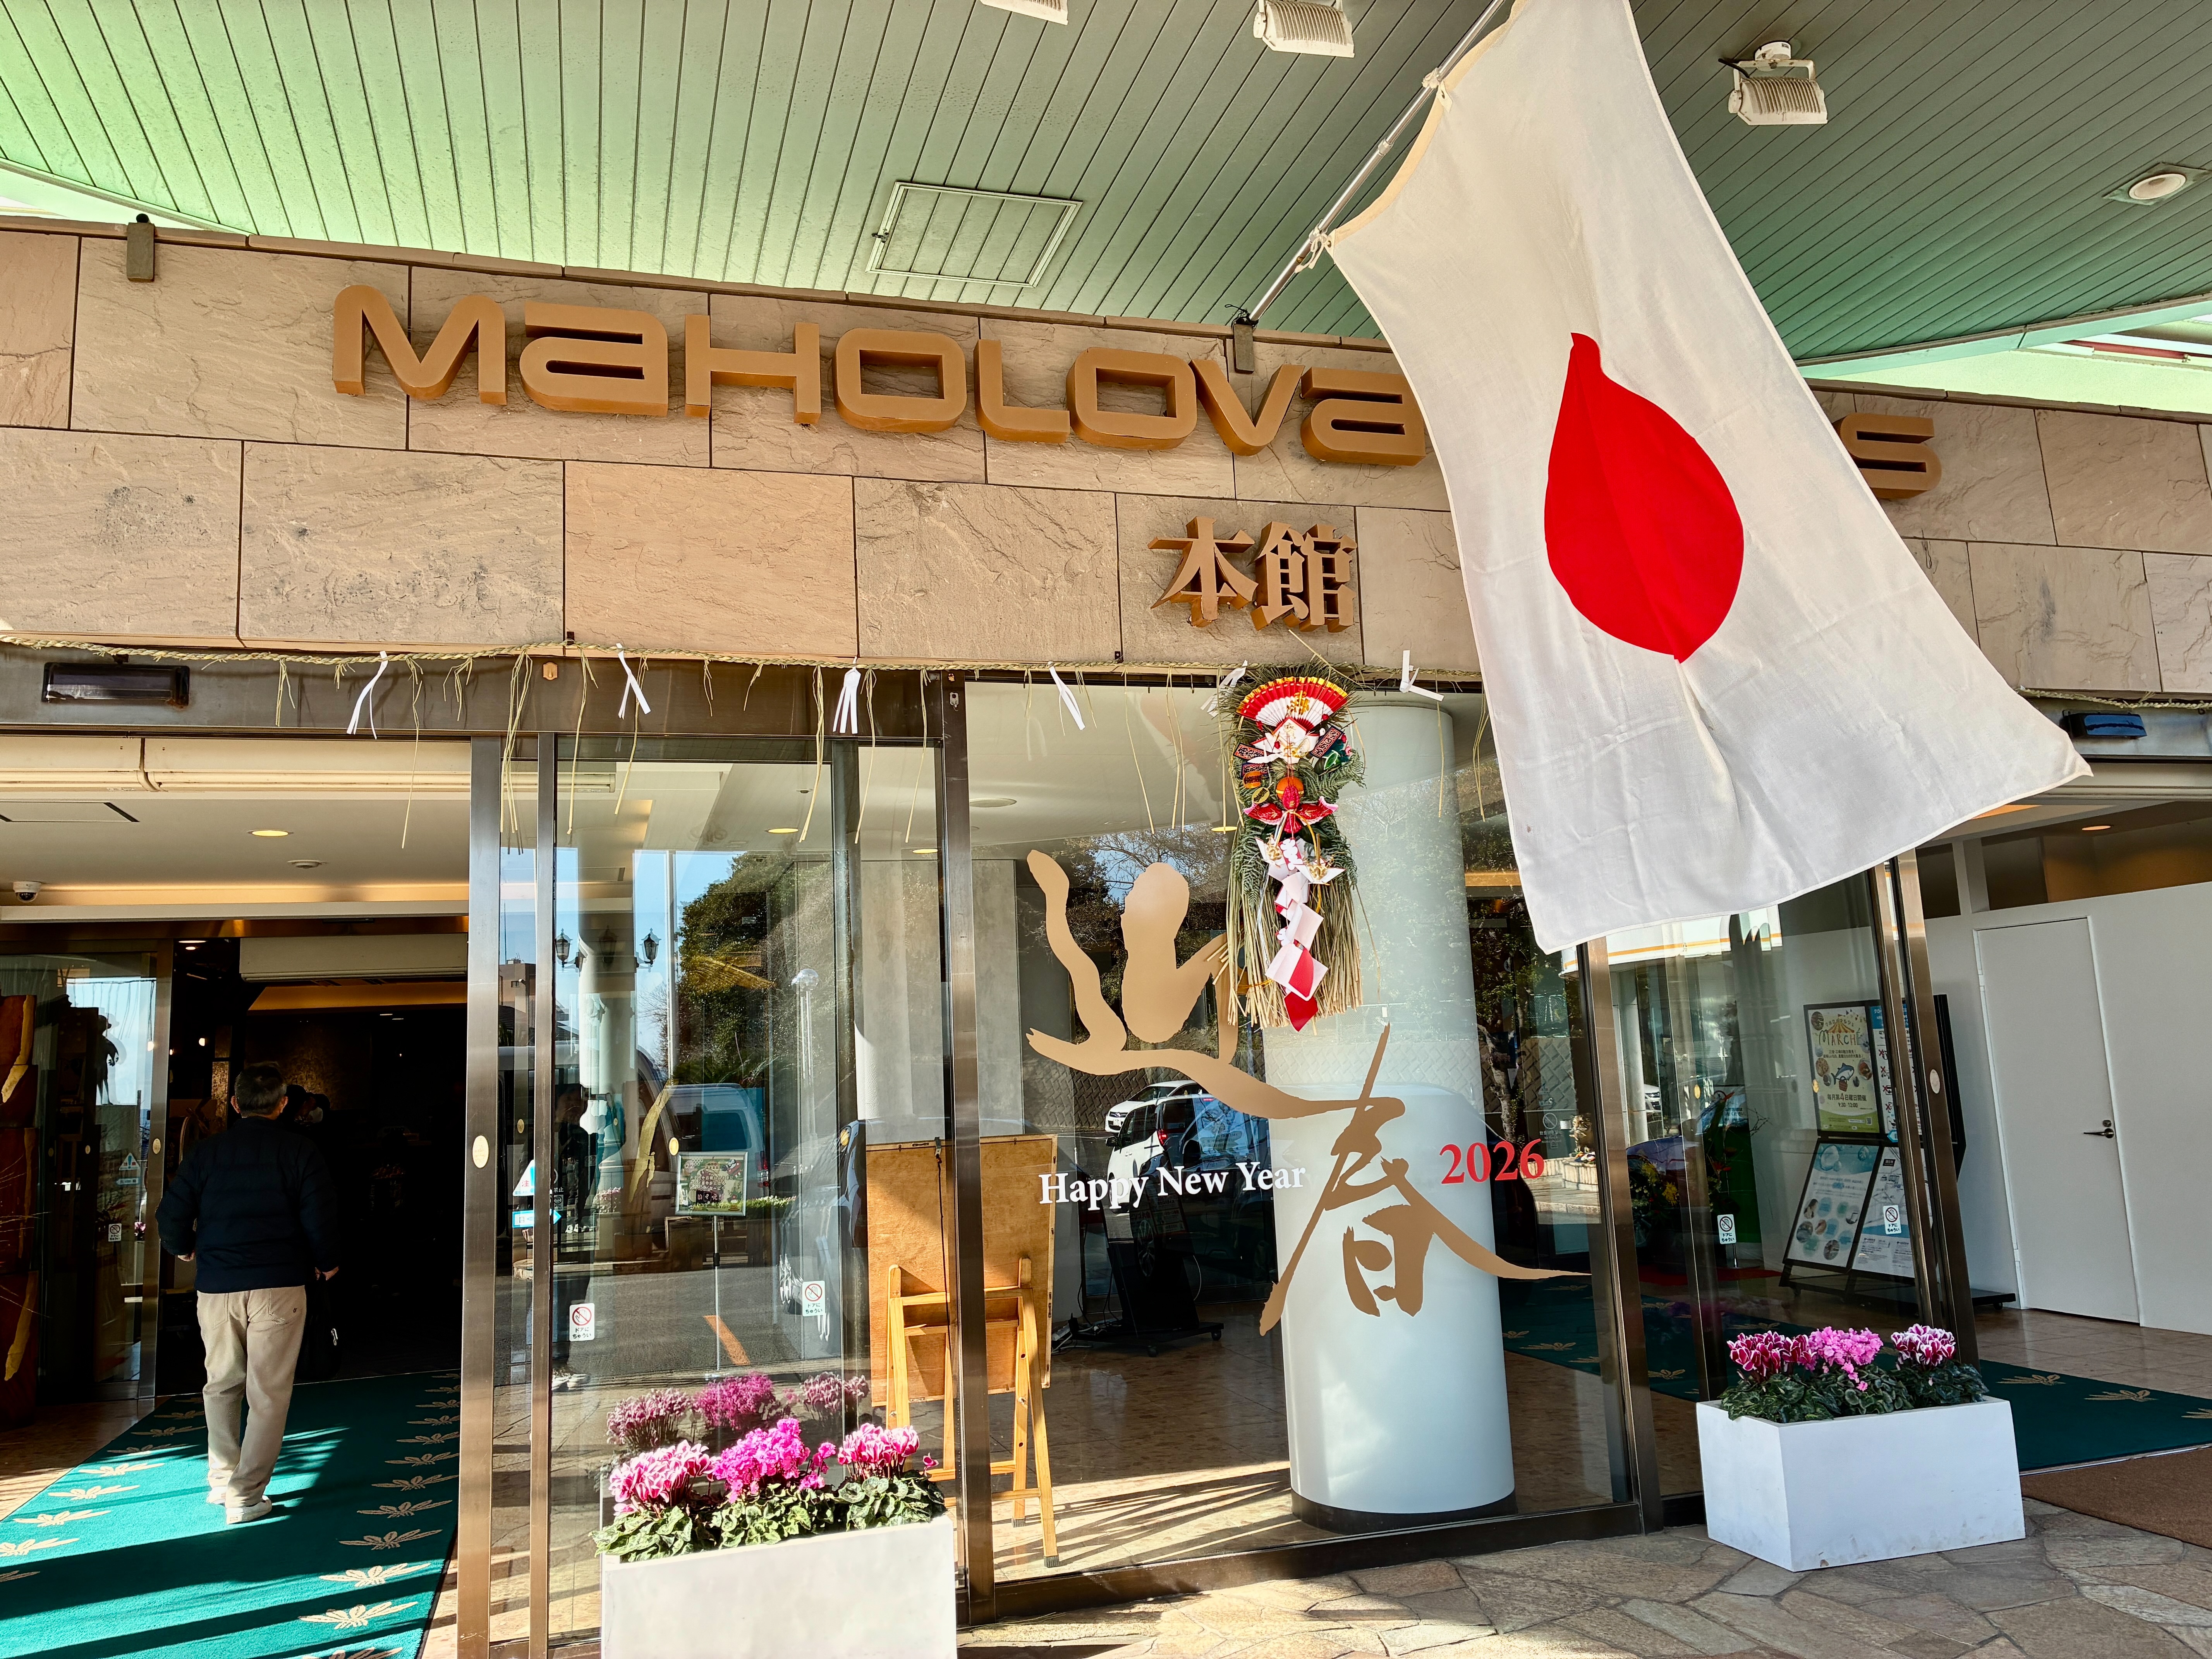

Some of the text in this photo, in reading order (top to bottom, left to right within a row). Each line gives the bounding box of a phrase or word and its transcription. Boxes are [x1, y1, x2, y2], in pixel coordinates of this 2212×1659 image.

[1147, 515, 1357, 633] 本館
[1440, 1139, 1545, 1184] 2026
[1038, 1162, 1306, 1211] Happy New Year
